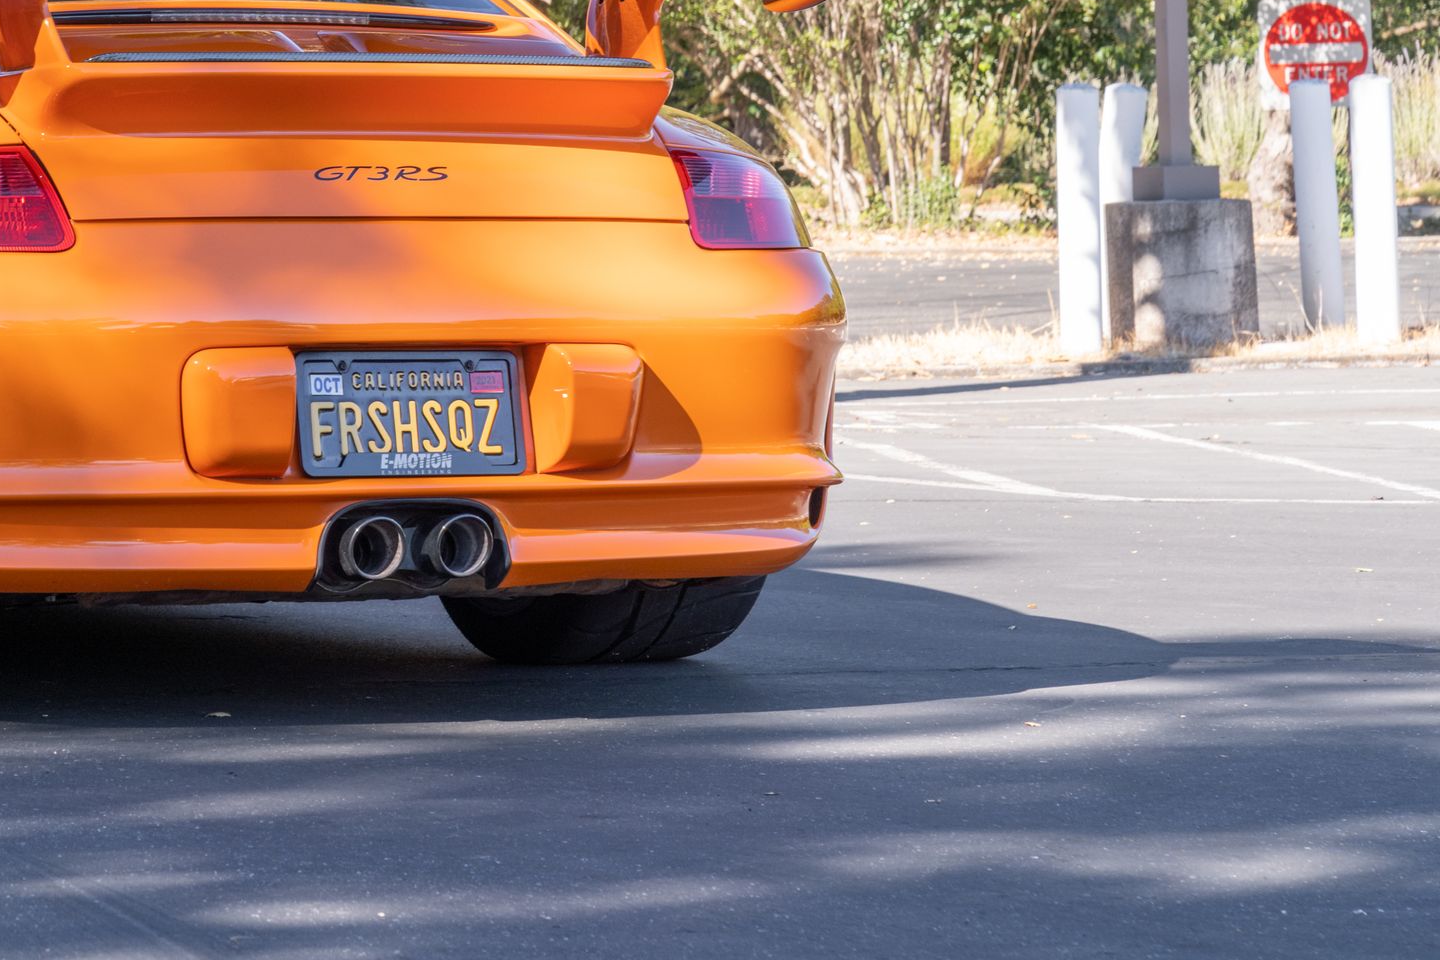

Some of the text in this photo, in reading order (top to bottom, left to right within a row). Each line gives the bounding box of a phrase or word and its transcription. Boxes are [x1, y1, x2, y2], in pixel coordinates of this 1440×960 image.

[1278, 20, 1352, 41] DO NOT
[1285, 65, 1348, 85] ENTER
[314, 165, 449, 182] GT3RS
[314, 377, 341, 393] OCT
[351, 371, 464, 390] CALIFORNIA
[310, 398, 503, 458] FRSHSQZ
[380, 452, 453, 470] E-MOTION
